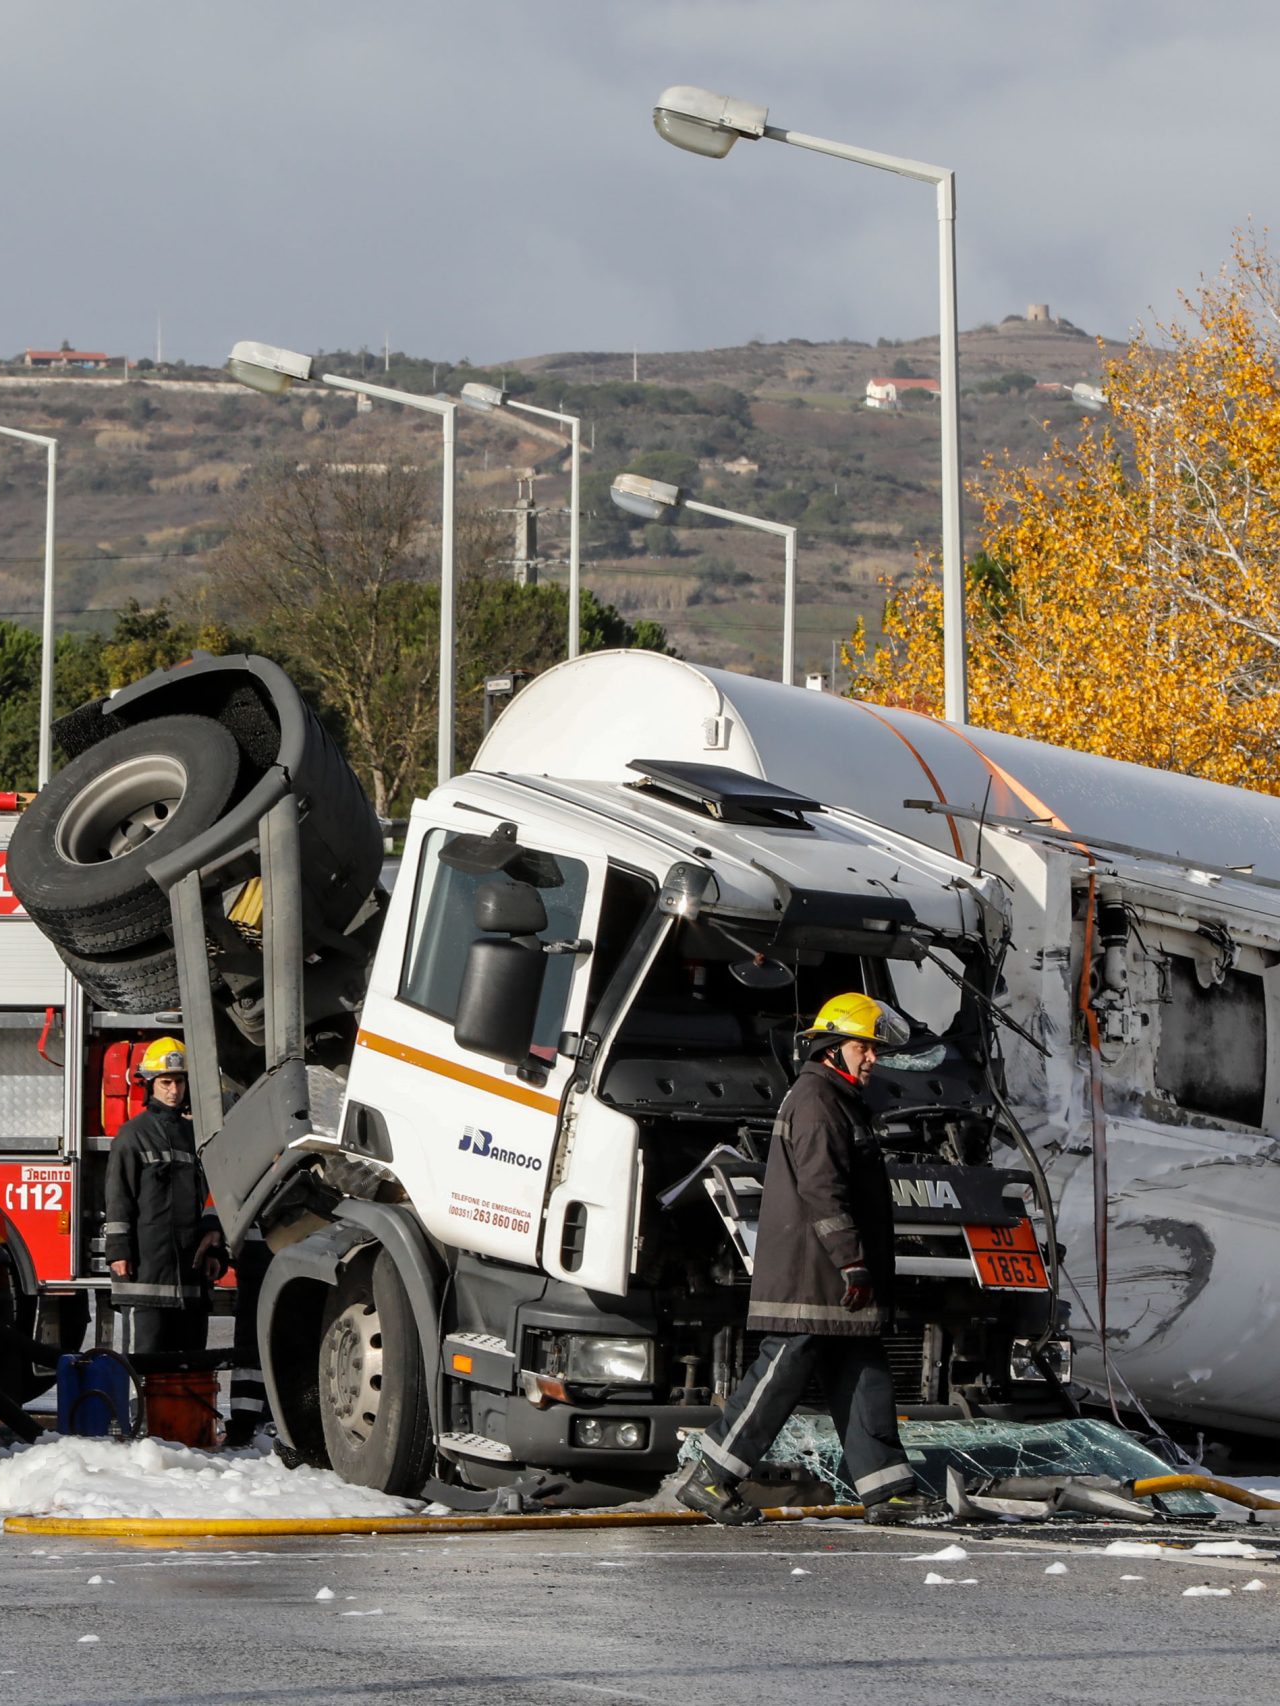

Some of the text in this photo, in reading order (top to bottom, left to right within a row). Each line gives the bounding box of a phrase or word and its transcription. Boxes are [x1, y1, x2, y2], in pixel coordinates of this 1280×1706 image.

[25, 1168, 71, 1180] JACINTO
[15, 1183, 63, 1210] 112
[451, 1192, 480, 1206] TELEFONE
[481, 1200, 491, 1208] DE
[449, 1205, 530, 1234] (00351) 263 860 060
[987, 1256, 1038, 1283] 1863
